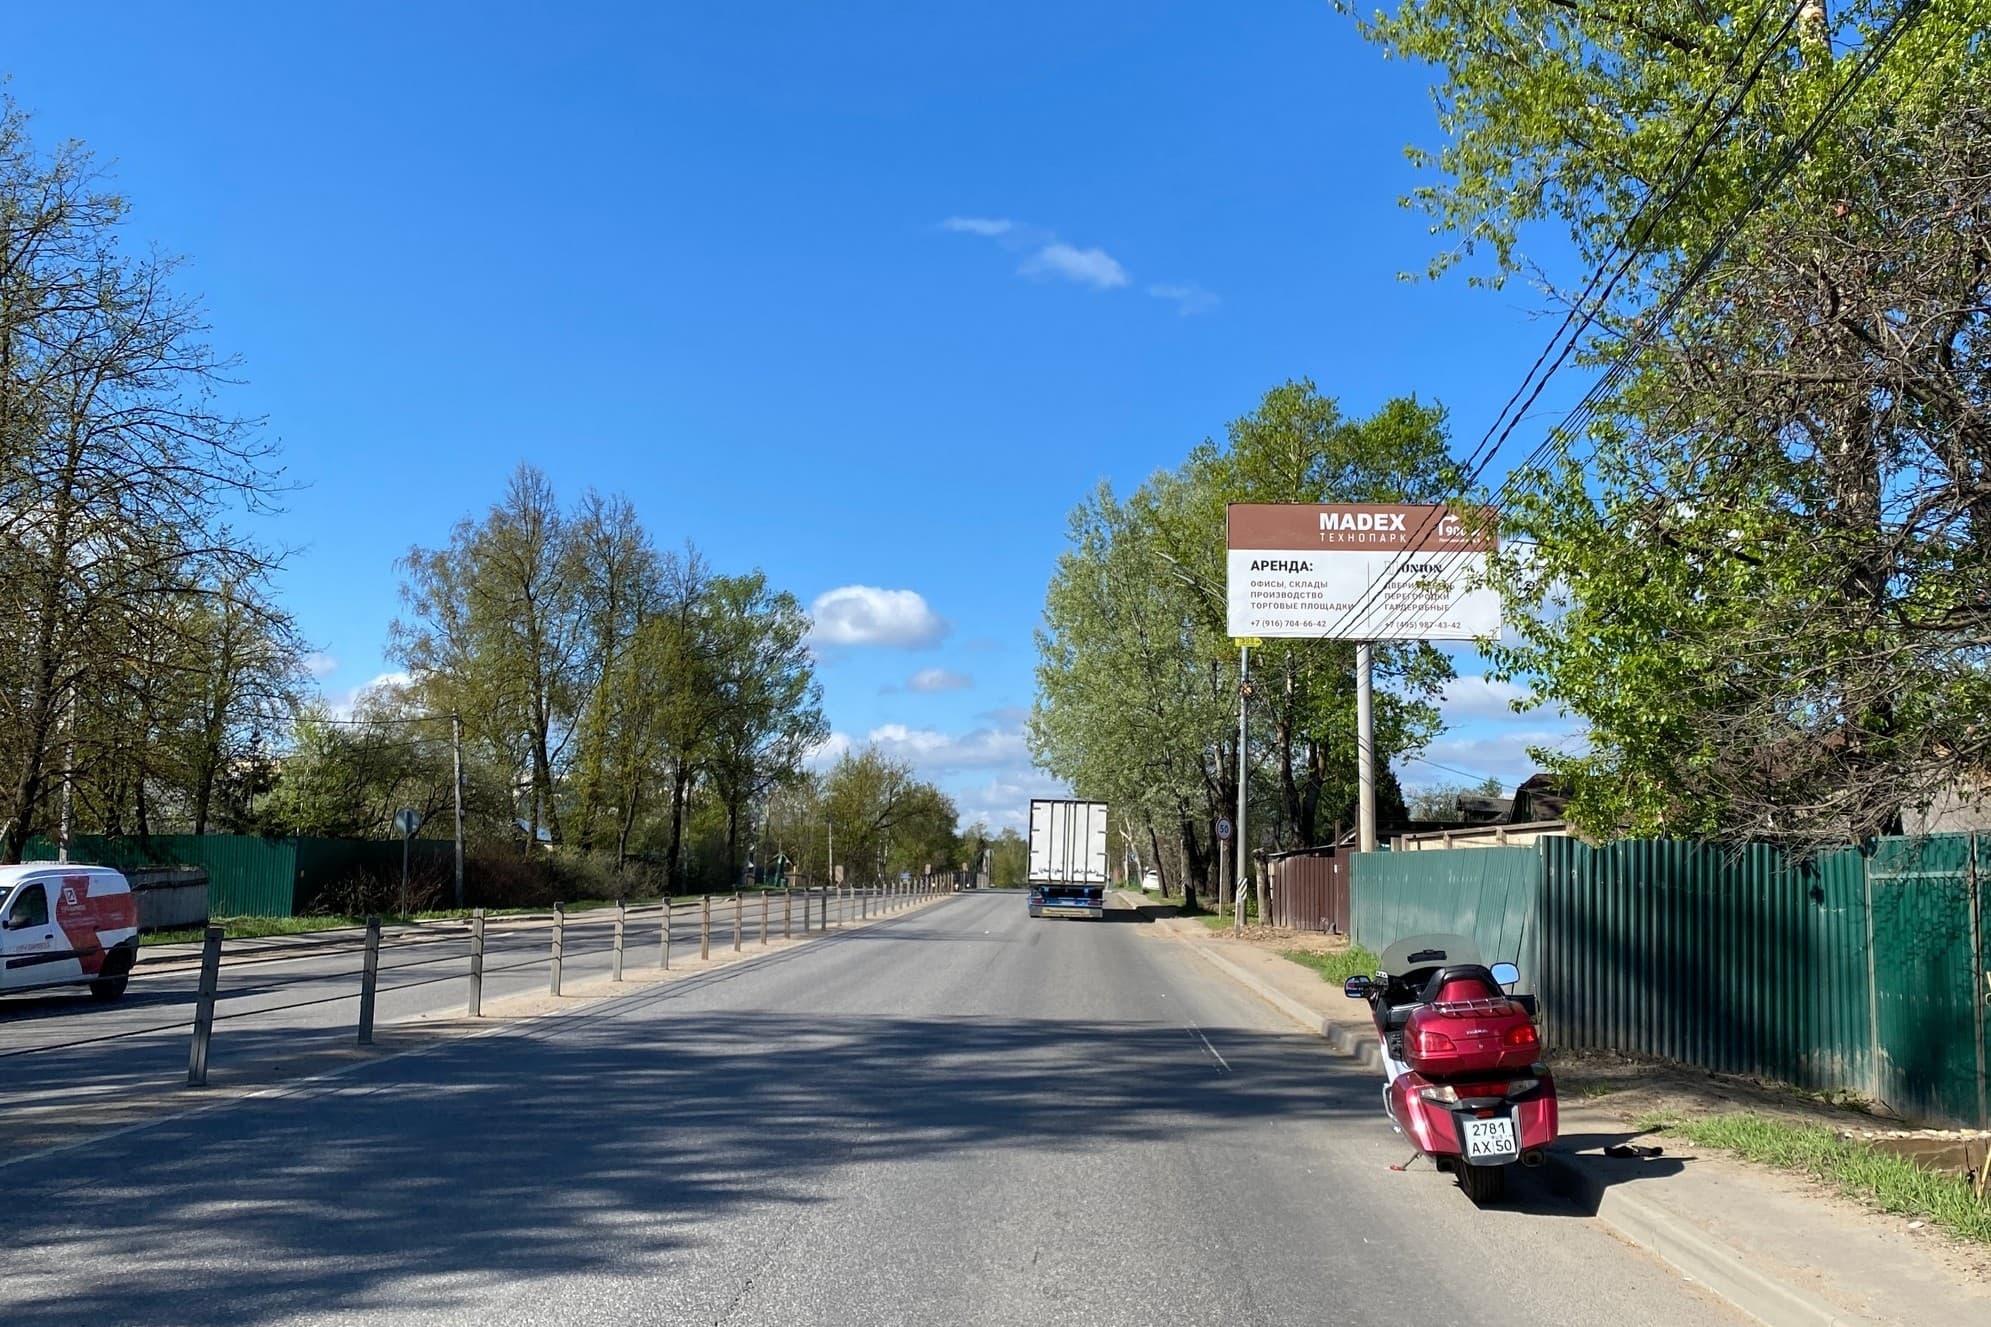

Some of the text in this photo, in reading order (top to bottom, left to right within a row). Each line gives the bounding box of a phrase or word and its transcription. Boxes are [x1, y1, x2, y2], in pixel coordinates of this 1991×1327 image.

[1319, 512, 1406, 531] MADEX
[1319, 533, 1407, 543] ТЕХНОПАРК
[1250, 559, 1314, 574] АРЕНДА:
[1250, 580, 1328, 589] ОФИСЫ, СКЛАДЫ
[1250, 591, 1324, 600] ПРОИЗВОДСТВО
[1250, 602, 1355, 611] ТОРГОВЫЕ ПЛОЩАДКИ
[1384, 603, 1450, 612] ГАРДЕРОБНЫЕ
[1250, 619, 1327, 629] +7 (916) 704-66-42
[1219, 823, 1229, 834] 50
[1472, 1121, 1506, 1137] 2781
[1495, 1139, 1512, 1152] 50
